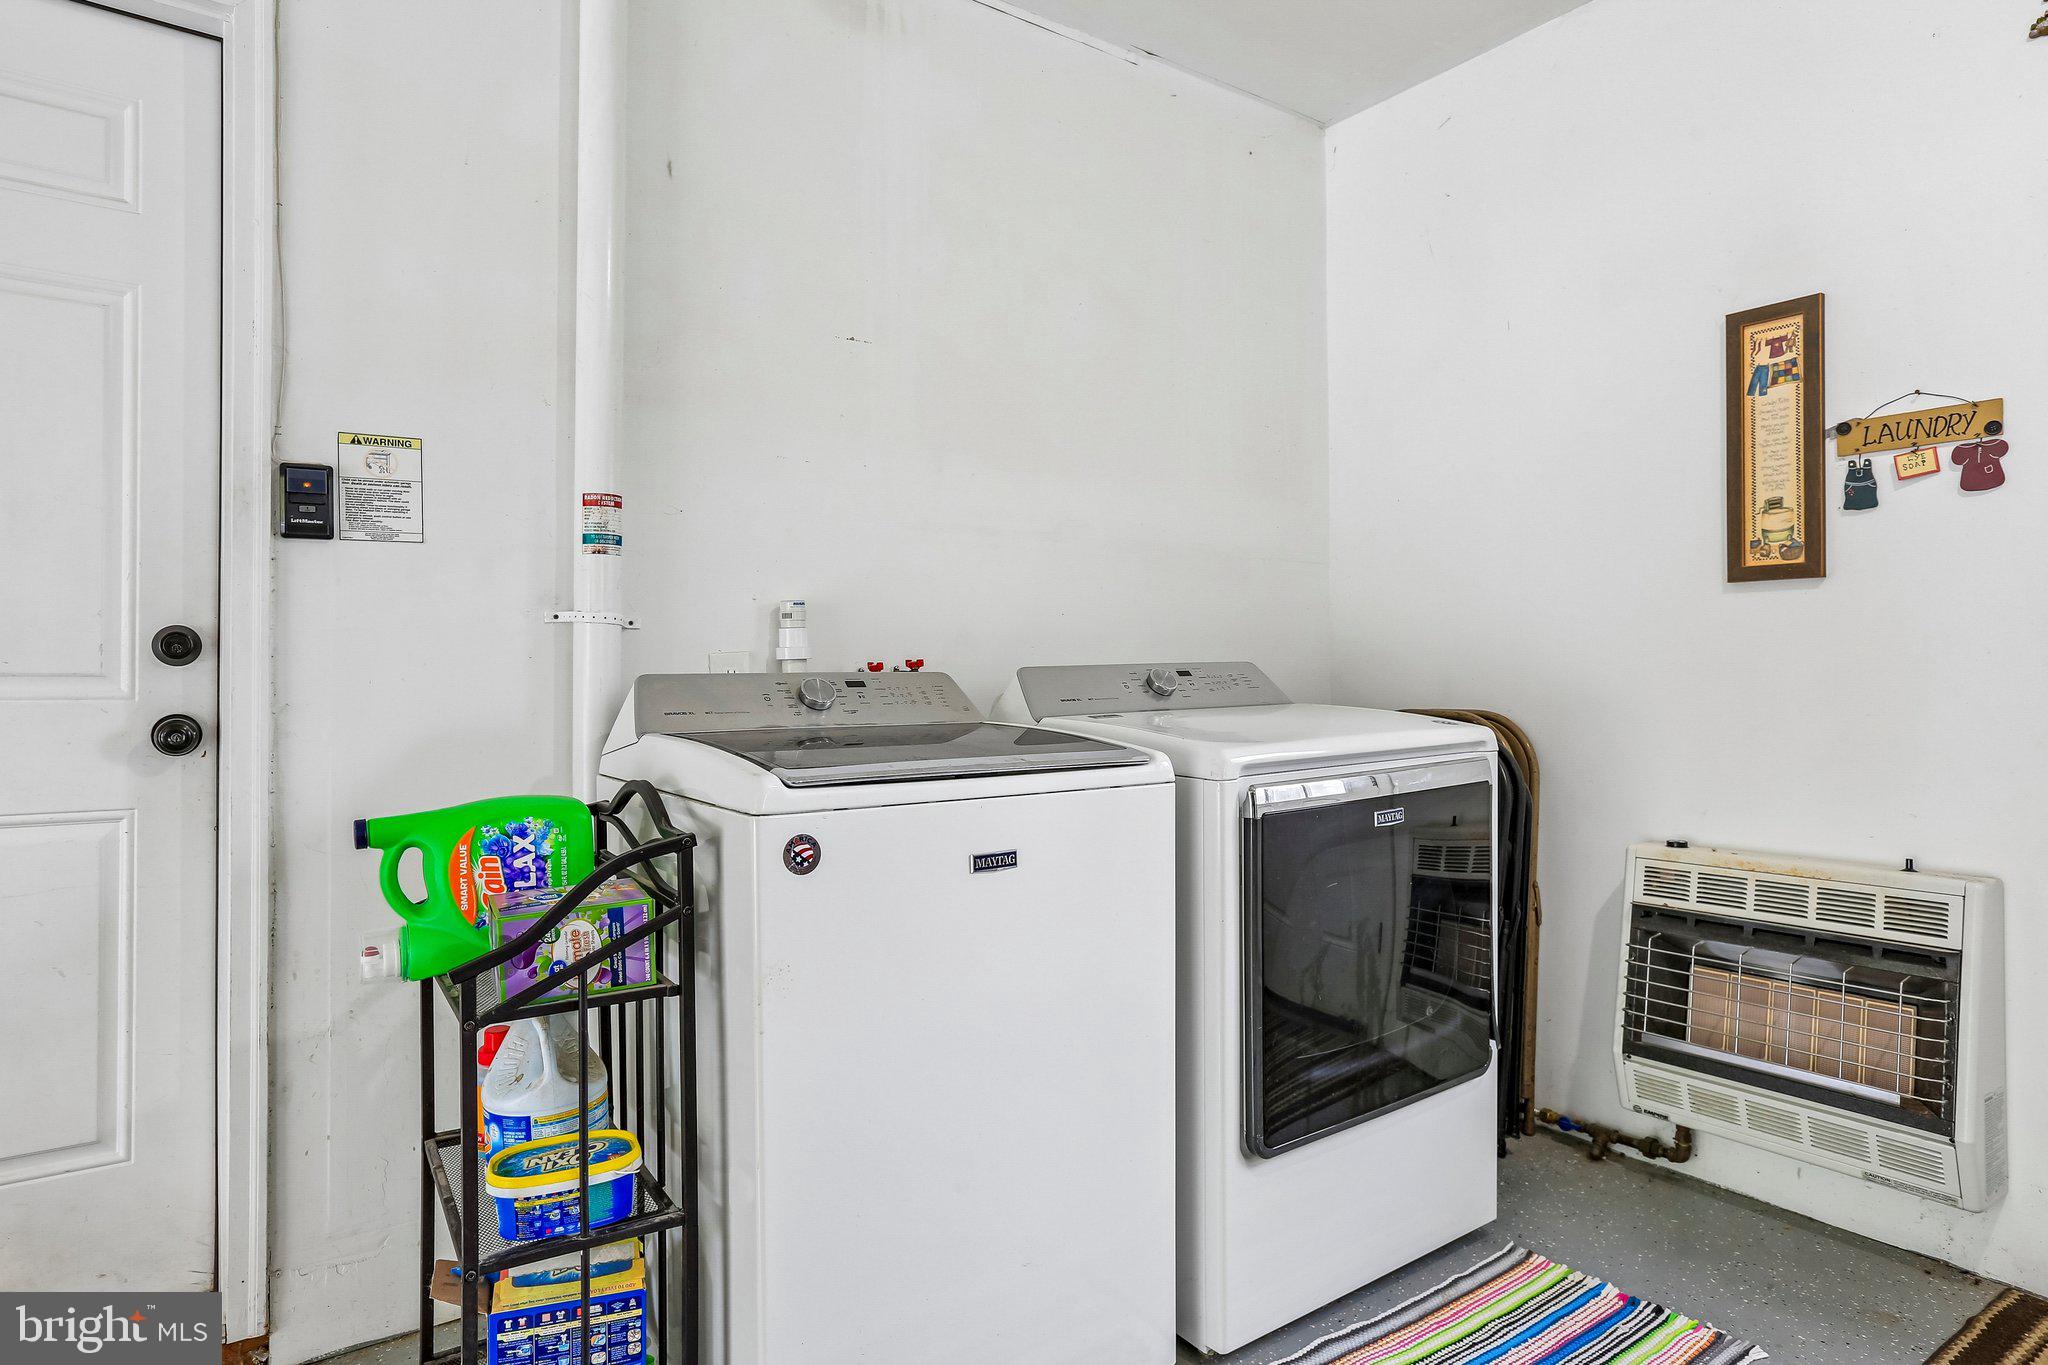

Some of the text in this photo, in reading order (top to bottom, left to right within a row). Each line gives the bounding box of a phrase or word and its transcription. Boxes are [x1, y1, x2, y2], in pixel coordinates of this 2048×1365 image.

[1862, 410, 1977, 447] LAUNDRY
[363, 436, 412, 448] WARNING
[1906, 452, 1926, 462] LYE
[1902, 460, 1926, 472] SOAP
[290, 517, 324, 525] LiftMaster
[1377, 810, 1403, 823] MAYTAG
[512, 833, 537, 890] LAX
[975, 854, 1016, 869] MAYTAG
[459, 843, 469, 911] SMART VALUE
[571, 929, 581, 961] mate
[523, 1141, 608, 1170] CEAN
[1864, 1171, 1891, 1182] CAUTION
